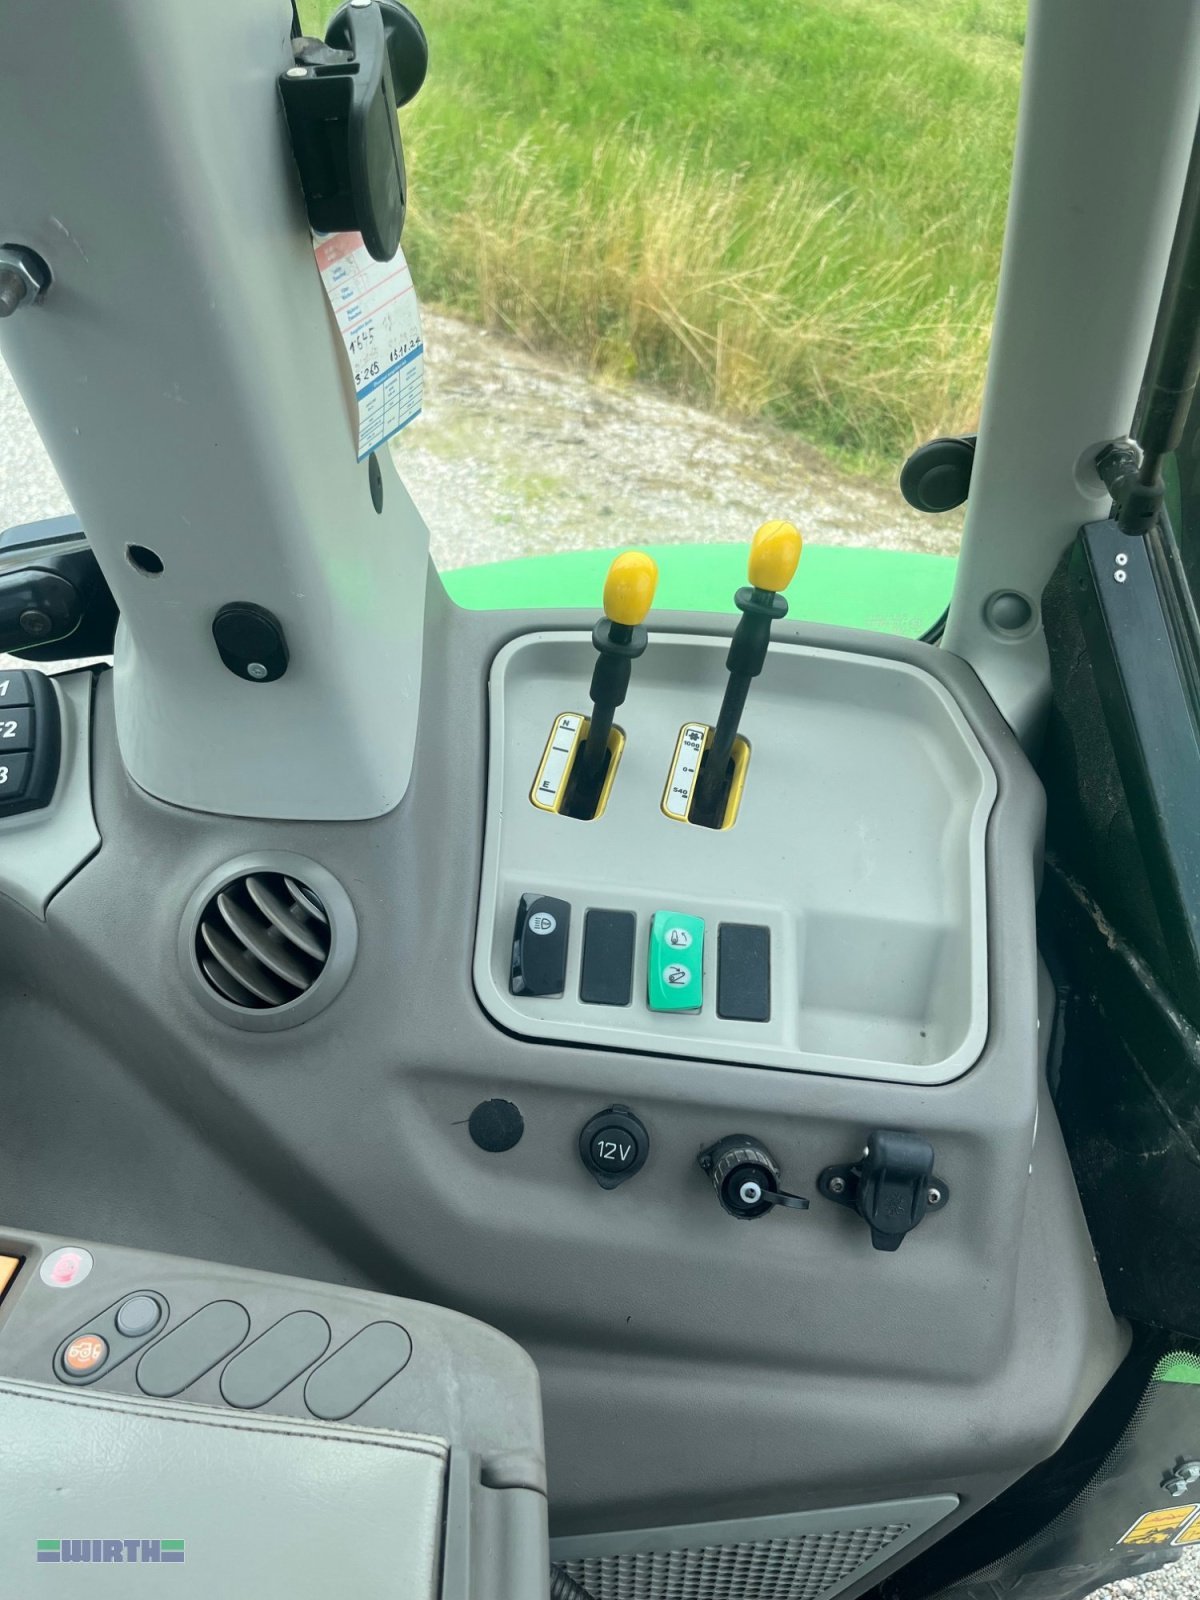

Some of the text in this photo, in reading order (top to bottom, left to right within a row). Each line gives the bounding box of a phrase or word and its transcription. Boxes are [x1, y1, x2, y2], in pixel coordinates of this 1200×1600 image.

[562, 719, 570, 727] N
[0, 720, 18, 738] 2
[683, 740, 700, 749] 1000
[542, 780, 550, 788] E
[672, 786, 688, 795] 540
[598, 1140, 631, 1161] 12V
